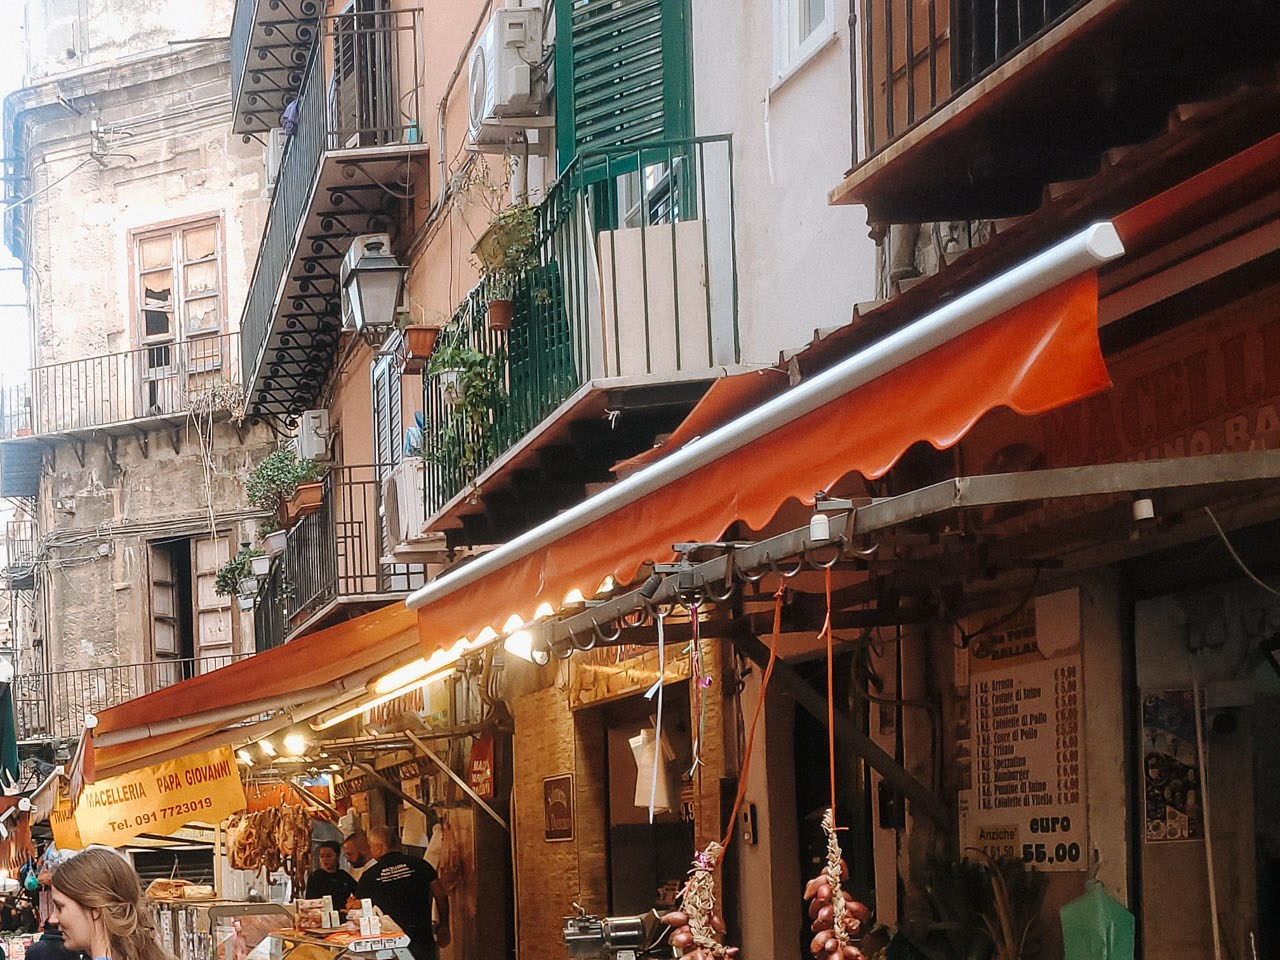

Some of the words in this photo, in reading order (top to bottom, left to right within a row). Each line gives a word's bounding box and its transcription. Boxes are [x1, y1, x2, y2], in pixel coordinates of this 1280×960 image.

[1015, 689, 1022, 701] di
[1021, 714, 1028, 726] di
[1012, 729, 1019, 741] di
[86, 782, 147, 809] MACELLERIA
[157, 773, 182, 794] PAPA
[185, 759, 232, 786] GIOVANNI
[110, 820, 133, 833] Tel.
[135, 811, 158, 826] 091
[160, 797, 213, 820] 7723019
[1030, 816, 1071, 834] euro
